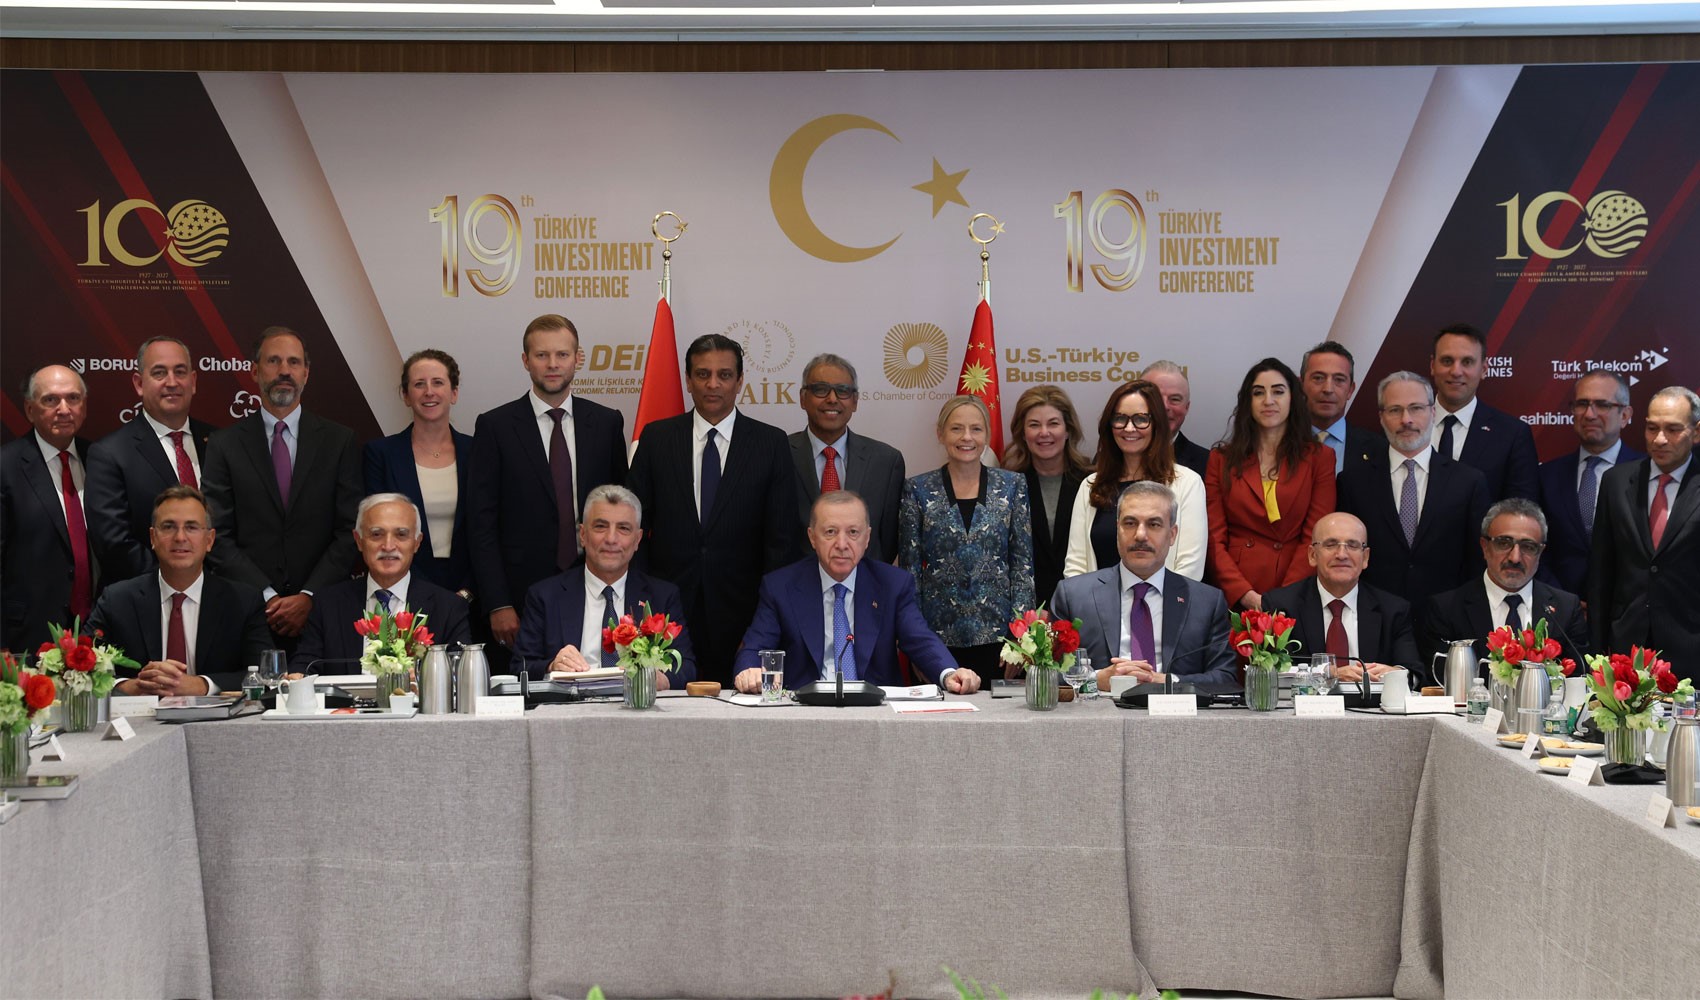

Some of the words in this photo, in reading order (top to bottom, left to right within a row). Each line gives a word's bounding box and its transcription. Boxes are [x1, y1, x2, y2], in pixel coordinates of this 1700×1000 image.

[533, 214, 597, 240] TÜRKİYE
[1158, 208, 1222, 234] TÜRKİYE
[534, 242, 654, 271] INVESTMENT
[1159, 237, 1280, 266] INVESTMENT
[534, 276, 629, 299] CONFERENCE
[1159, 271, 1254, 293] CONFERENCE
[199, 357, 252, 371] Choba
[1005, 347, 1140, 366] U.S.-Türkiye
[1486, 356, 1513, 366] KISH
[1485, 367, 1513, 377] INES
[1551, 360, 1581, 372] Türk
[1585, 360, 1643, 372] Telekom
[1005, 367, 1102, 383] Business
[570, 387, 604, 395] CONOMIC
[606, 387, 640, 395] RELATION
[738, 377, 796, 405] AİK
[873, 391, 914, 401] Chamber
[917, 391, 927, 401] of
[1519, 412, 1574, 425] sahibin
